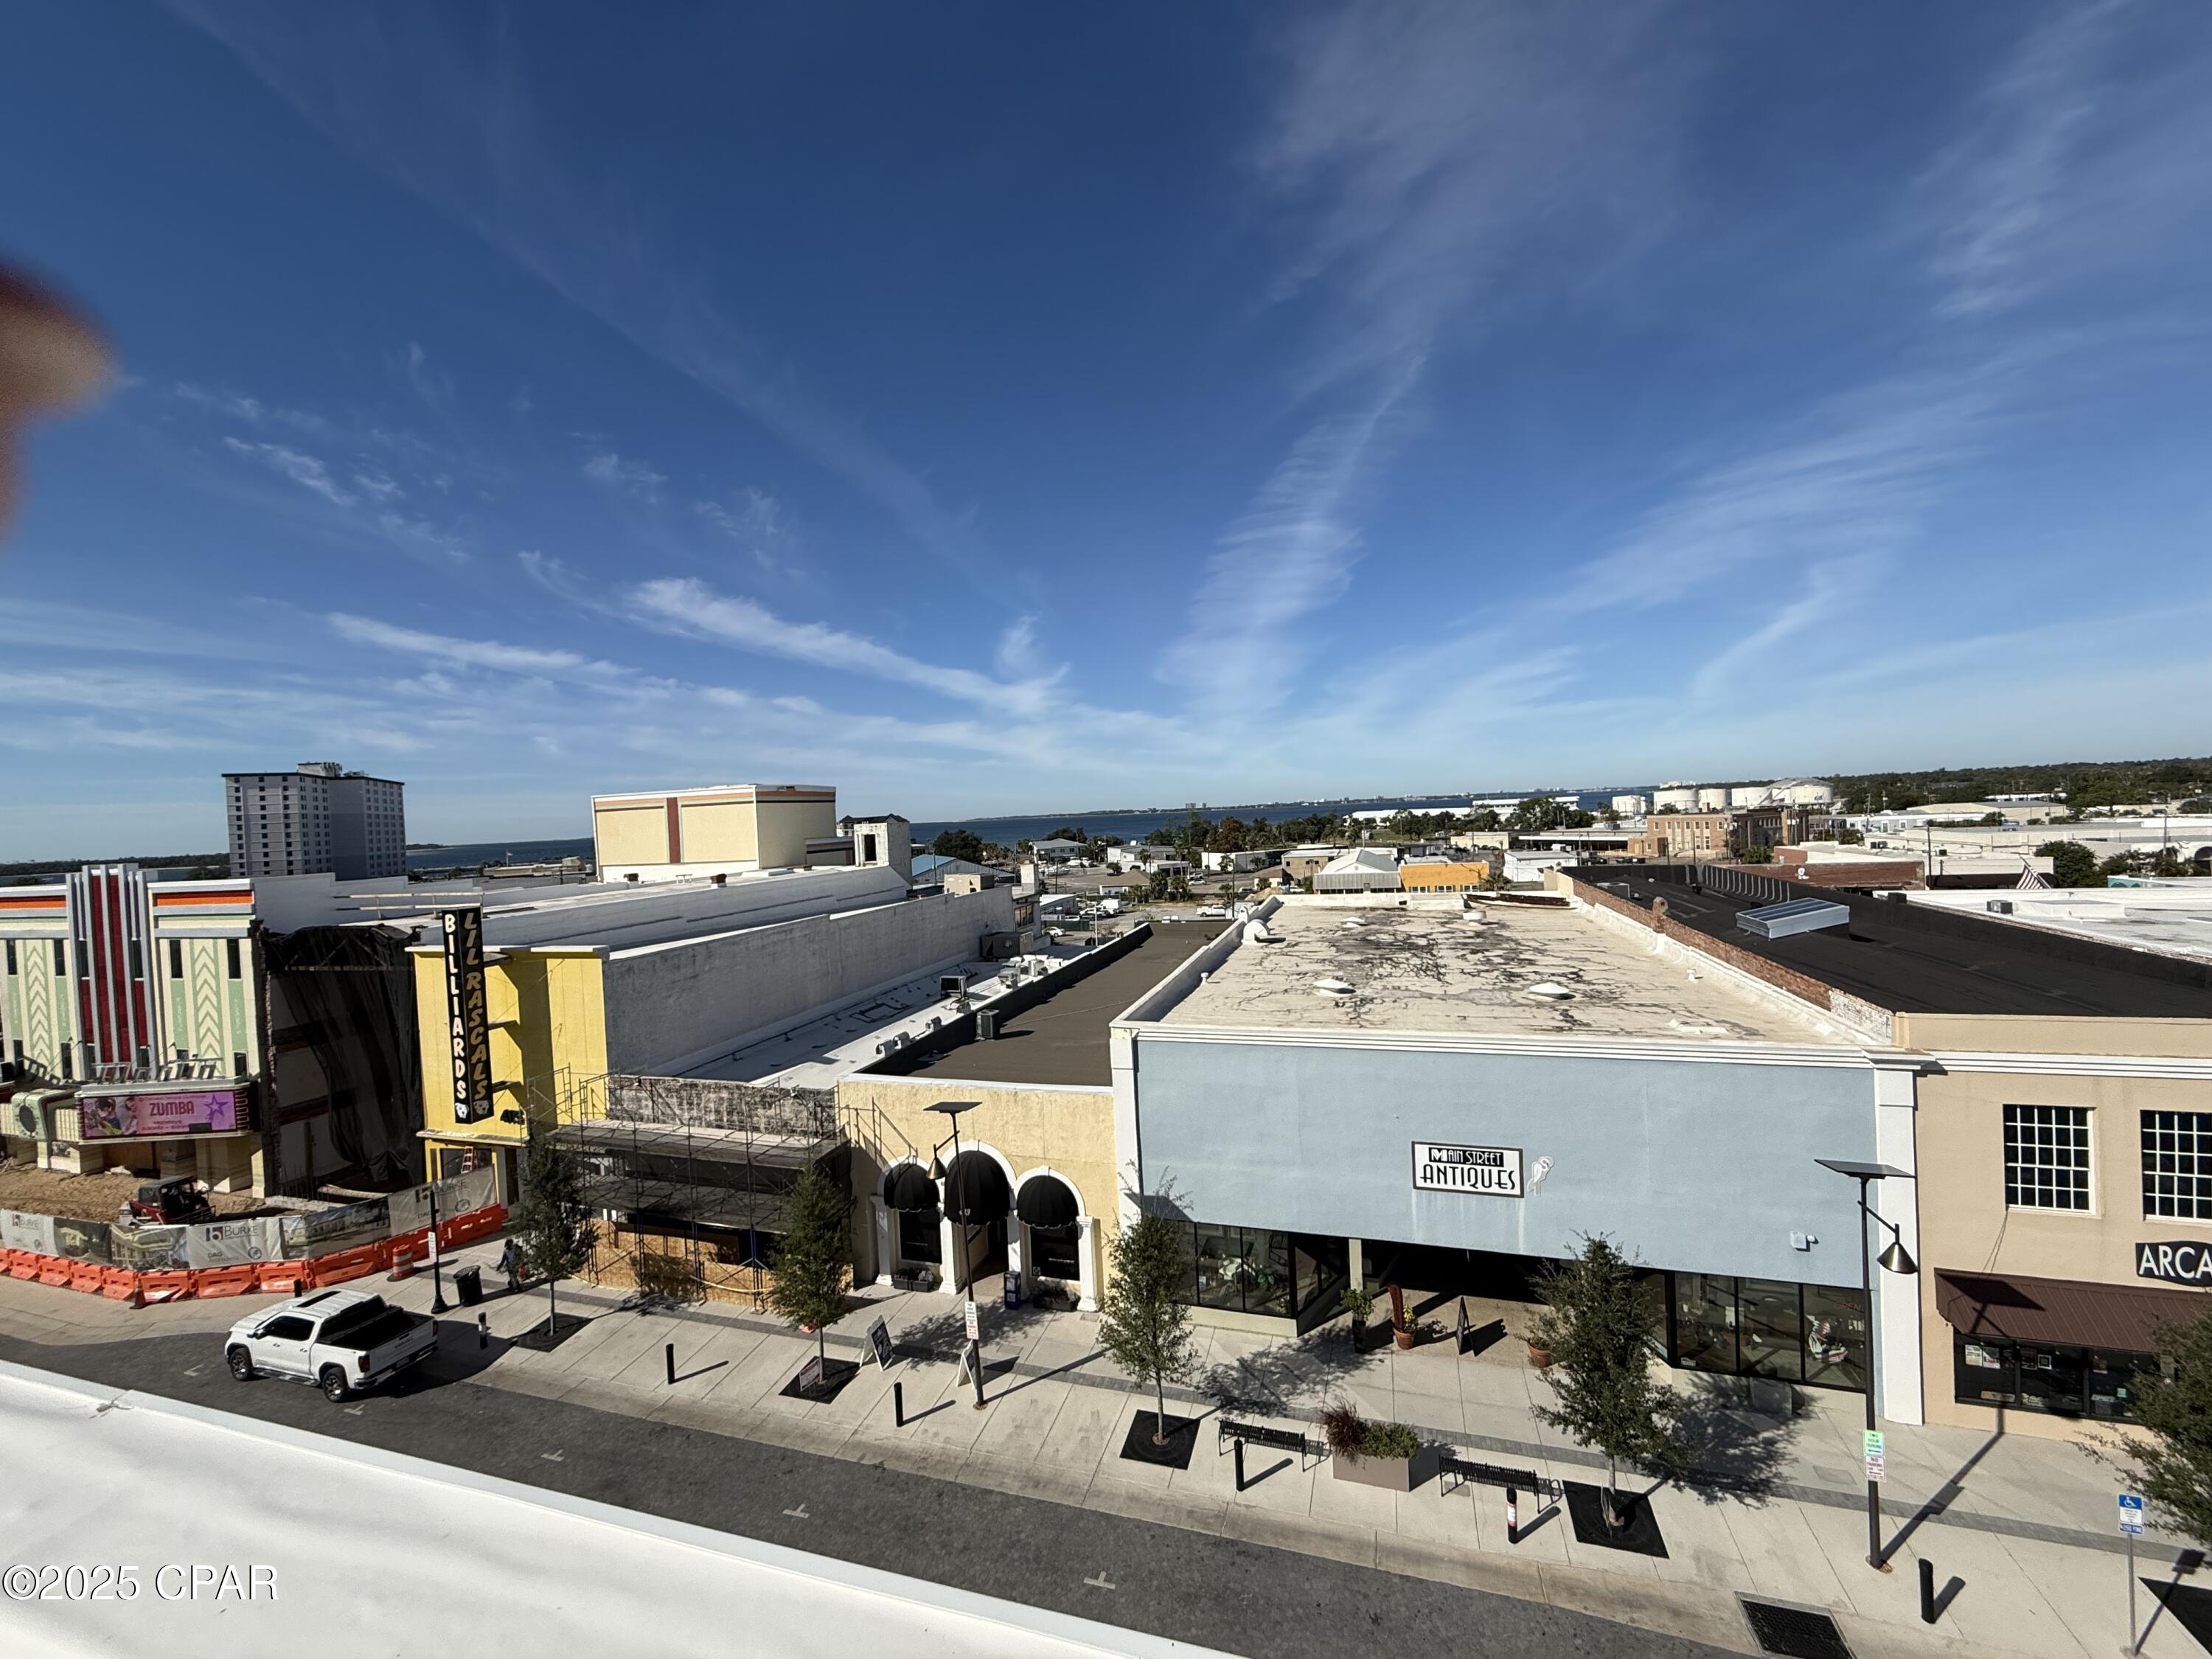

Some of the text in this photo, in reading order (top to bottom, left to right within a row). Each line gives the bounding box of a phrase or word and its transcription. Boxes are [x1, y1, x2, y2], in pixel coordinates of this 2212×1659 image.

[444, 914, 467, 1099] BILLIARDS
[465, 912, 487, 1099] LIL RASCALS
[150, 1101, 195, 1116] ZUMBA
[1431, 1149, 1501, 1166] MAIN STREET
[1420, 1164, 1515, 1190] ANTIQUES
[224, 1225, 258, 1237] BURKE
[2139, 1244, 2212, 1279] ARCA
